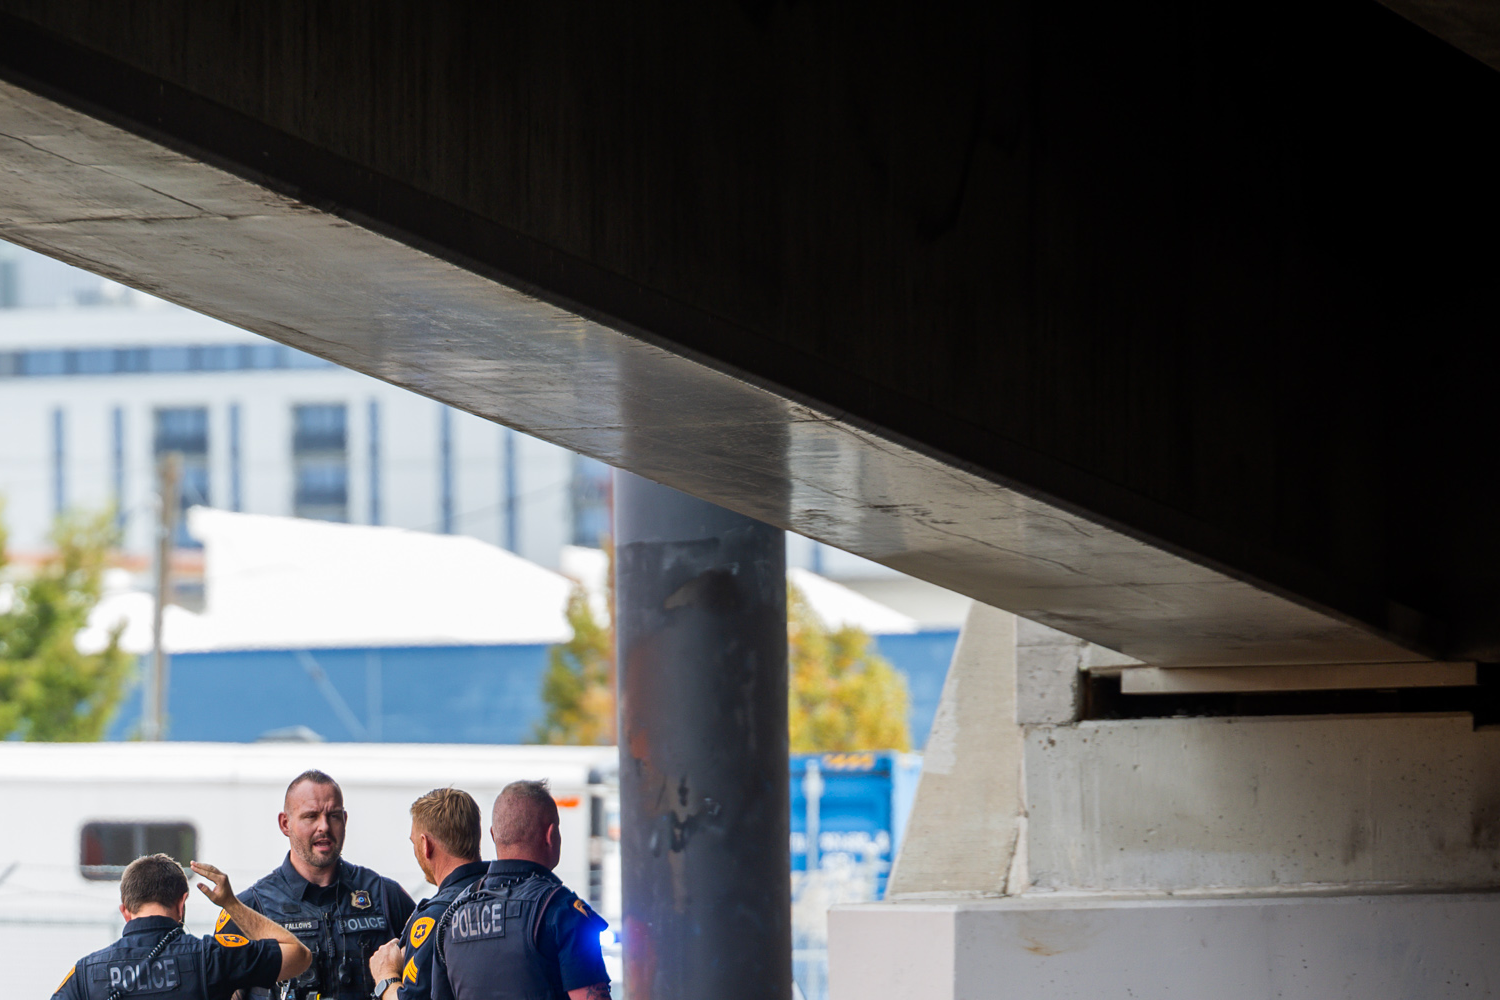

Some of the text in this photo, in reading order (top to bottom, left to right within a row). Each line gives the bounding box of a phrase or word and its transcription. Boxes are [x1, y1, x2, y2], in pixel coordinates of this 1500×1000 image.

[284, 921, 312, 931] FALLOWS
[451, 903, 502, 939] POLICE
[109, 958, 178, 992] POLICE
